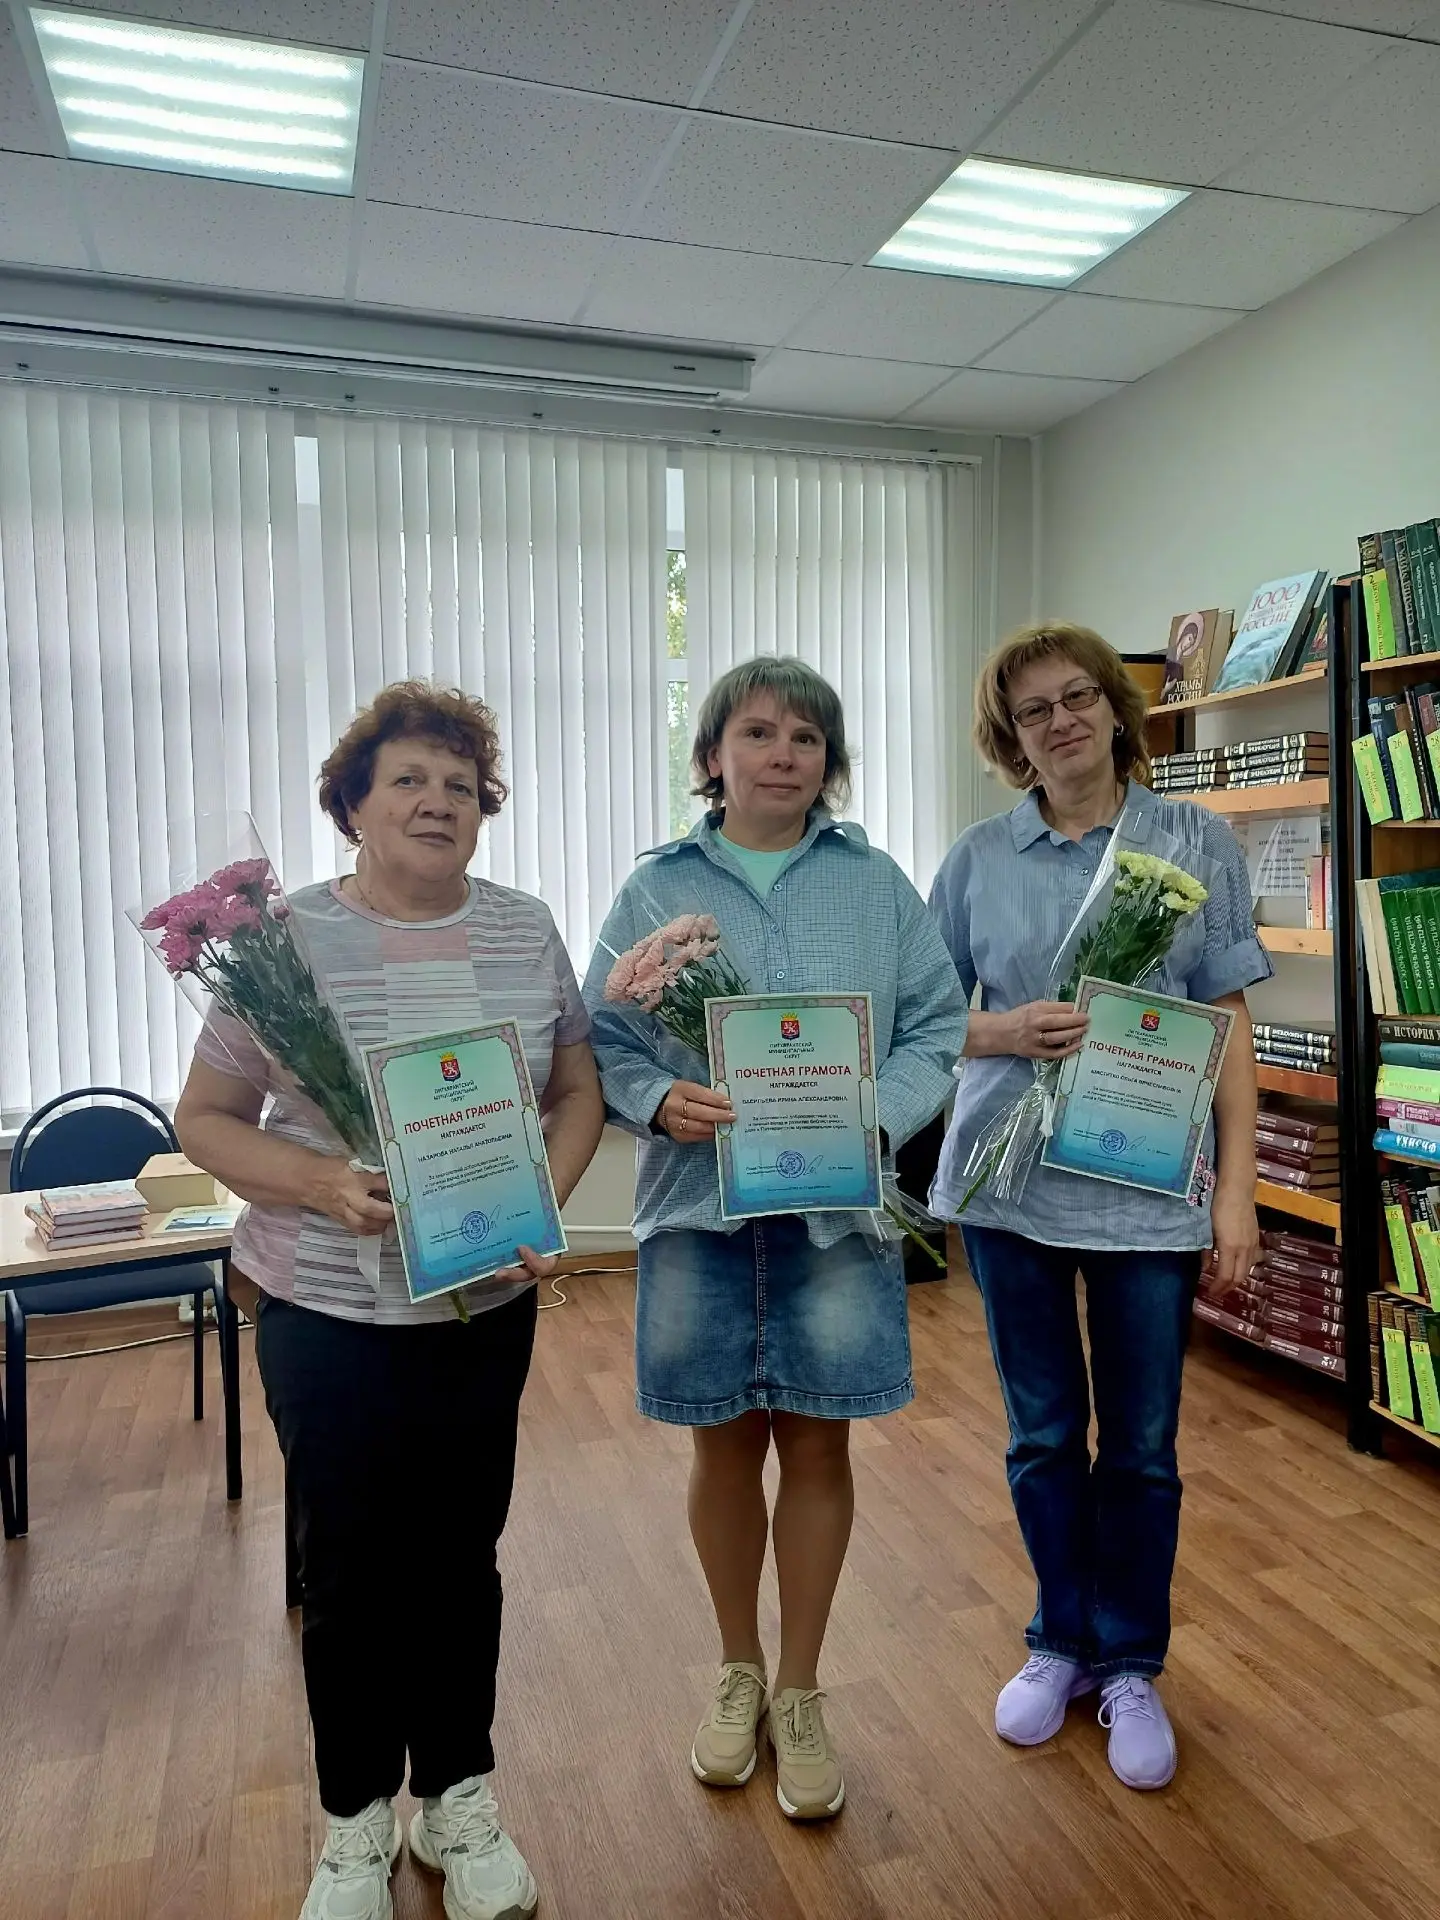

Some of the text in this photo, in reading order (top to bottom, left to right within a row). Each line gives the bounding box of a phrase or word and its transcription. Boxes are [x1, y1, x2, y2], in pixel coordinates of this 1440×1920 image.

[1251, 581, 1302, 611] 1000
[1174, 679, 1203, 693] ХРАМЫ
[1167, 690, 1203, 705] РОССИИ
[1393, 1025, 1435, 1041] ИСТОРИЯ
[1088, 1040, 1196, 1073] ПОЧЕТНАЯ ГРАМОТА
[735, 1064, 851, 1078] ПОЧЕТНАЯ ГРАМОТА
[1116, 1060, 1162, 1075] НАГРАЖДАЕТСЯ
[769, 1080, 818, 1089] НАГРАЖДАЕТСЯ
[798, 1094, 847, 1103] АЛЕКСАНДРОВНА
[403, 1097, 514, 1134] ПОЧЕТНАЯ ГРАМОТА
[440, 1122, 486, 1140] НАГРАЖДАЕТСЯ
[417, 1149, 448, 1162] НАЗАРОВА
[1390, 1211, 1399, 1220] 65
